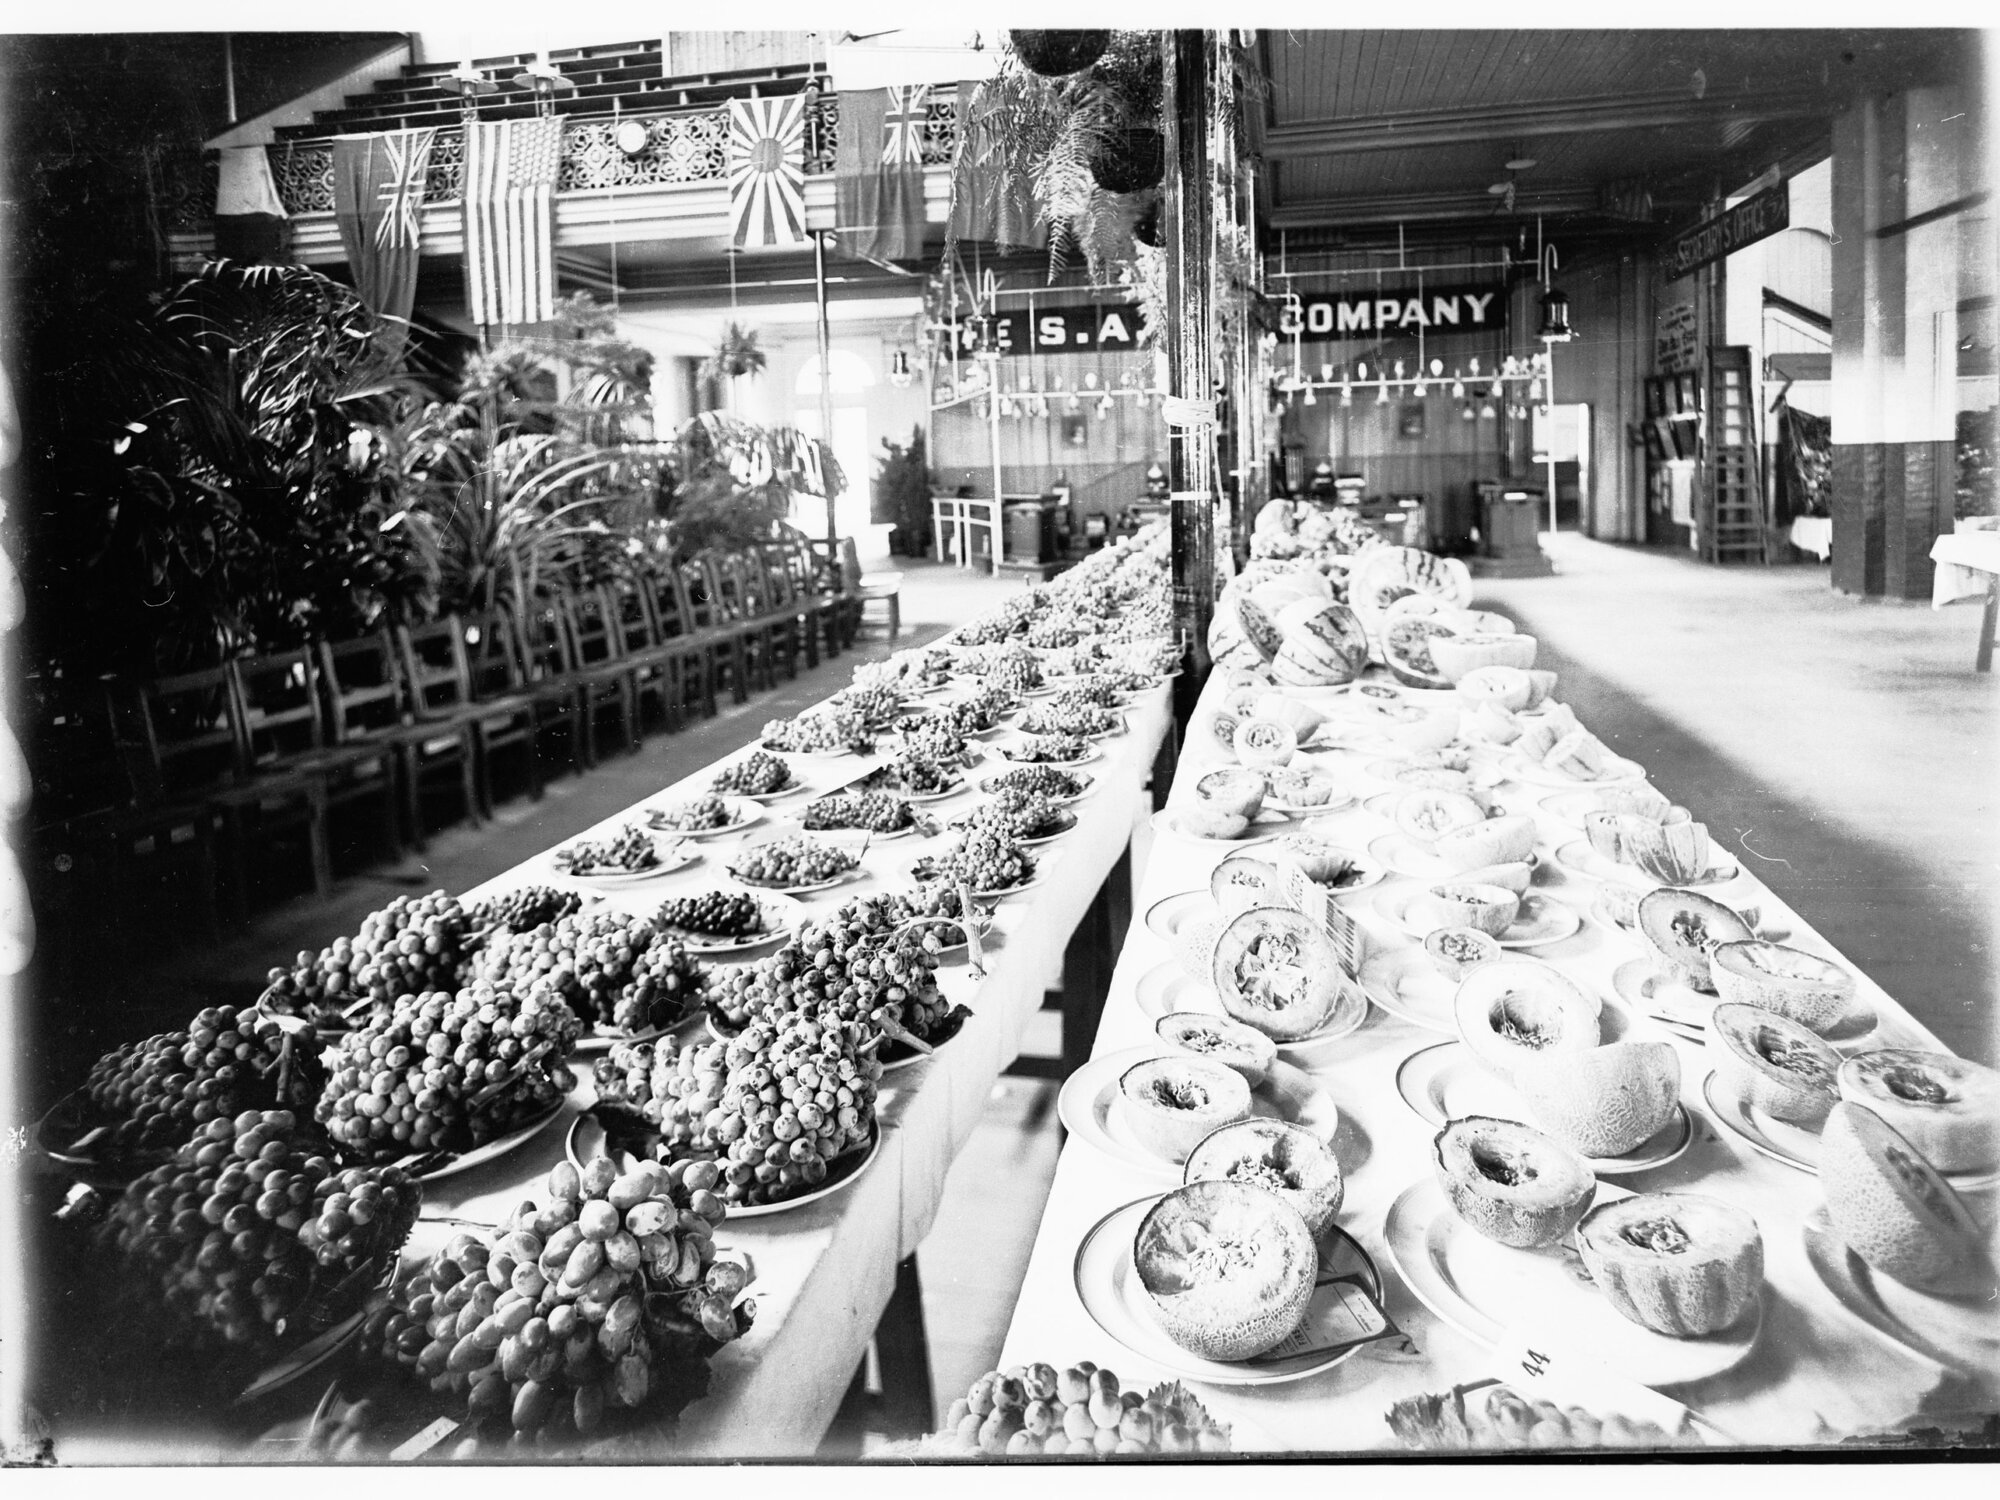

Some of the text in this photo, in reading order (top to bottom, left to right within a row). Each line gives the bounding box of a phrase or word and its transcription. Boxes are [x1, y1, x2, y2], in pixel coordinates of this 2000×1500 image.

[1733, 198, 1766, 243] OFFICE
[1279, 293, 1495, 334] COMPANY
[1521, 1348, 1551, 1377] 44
